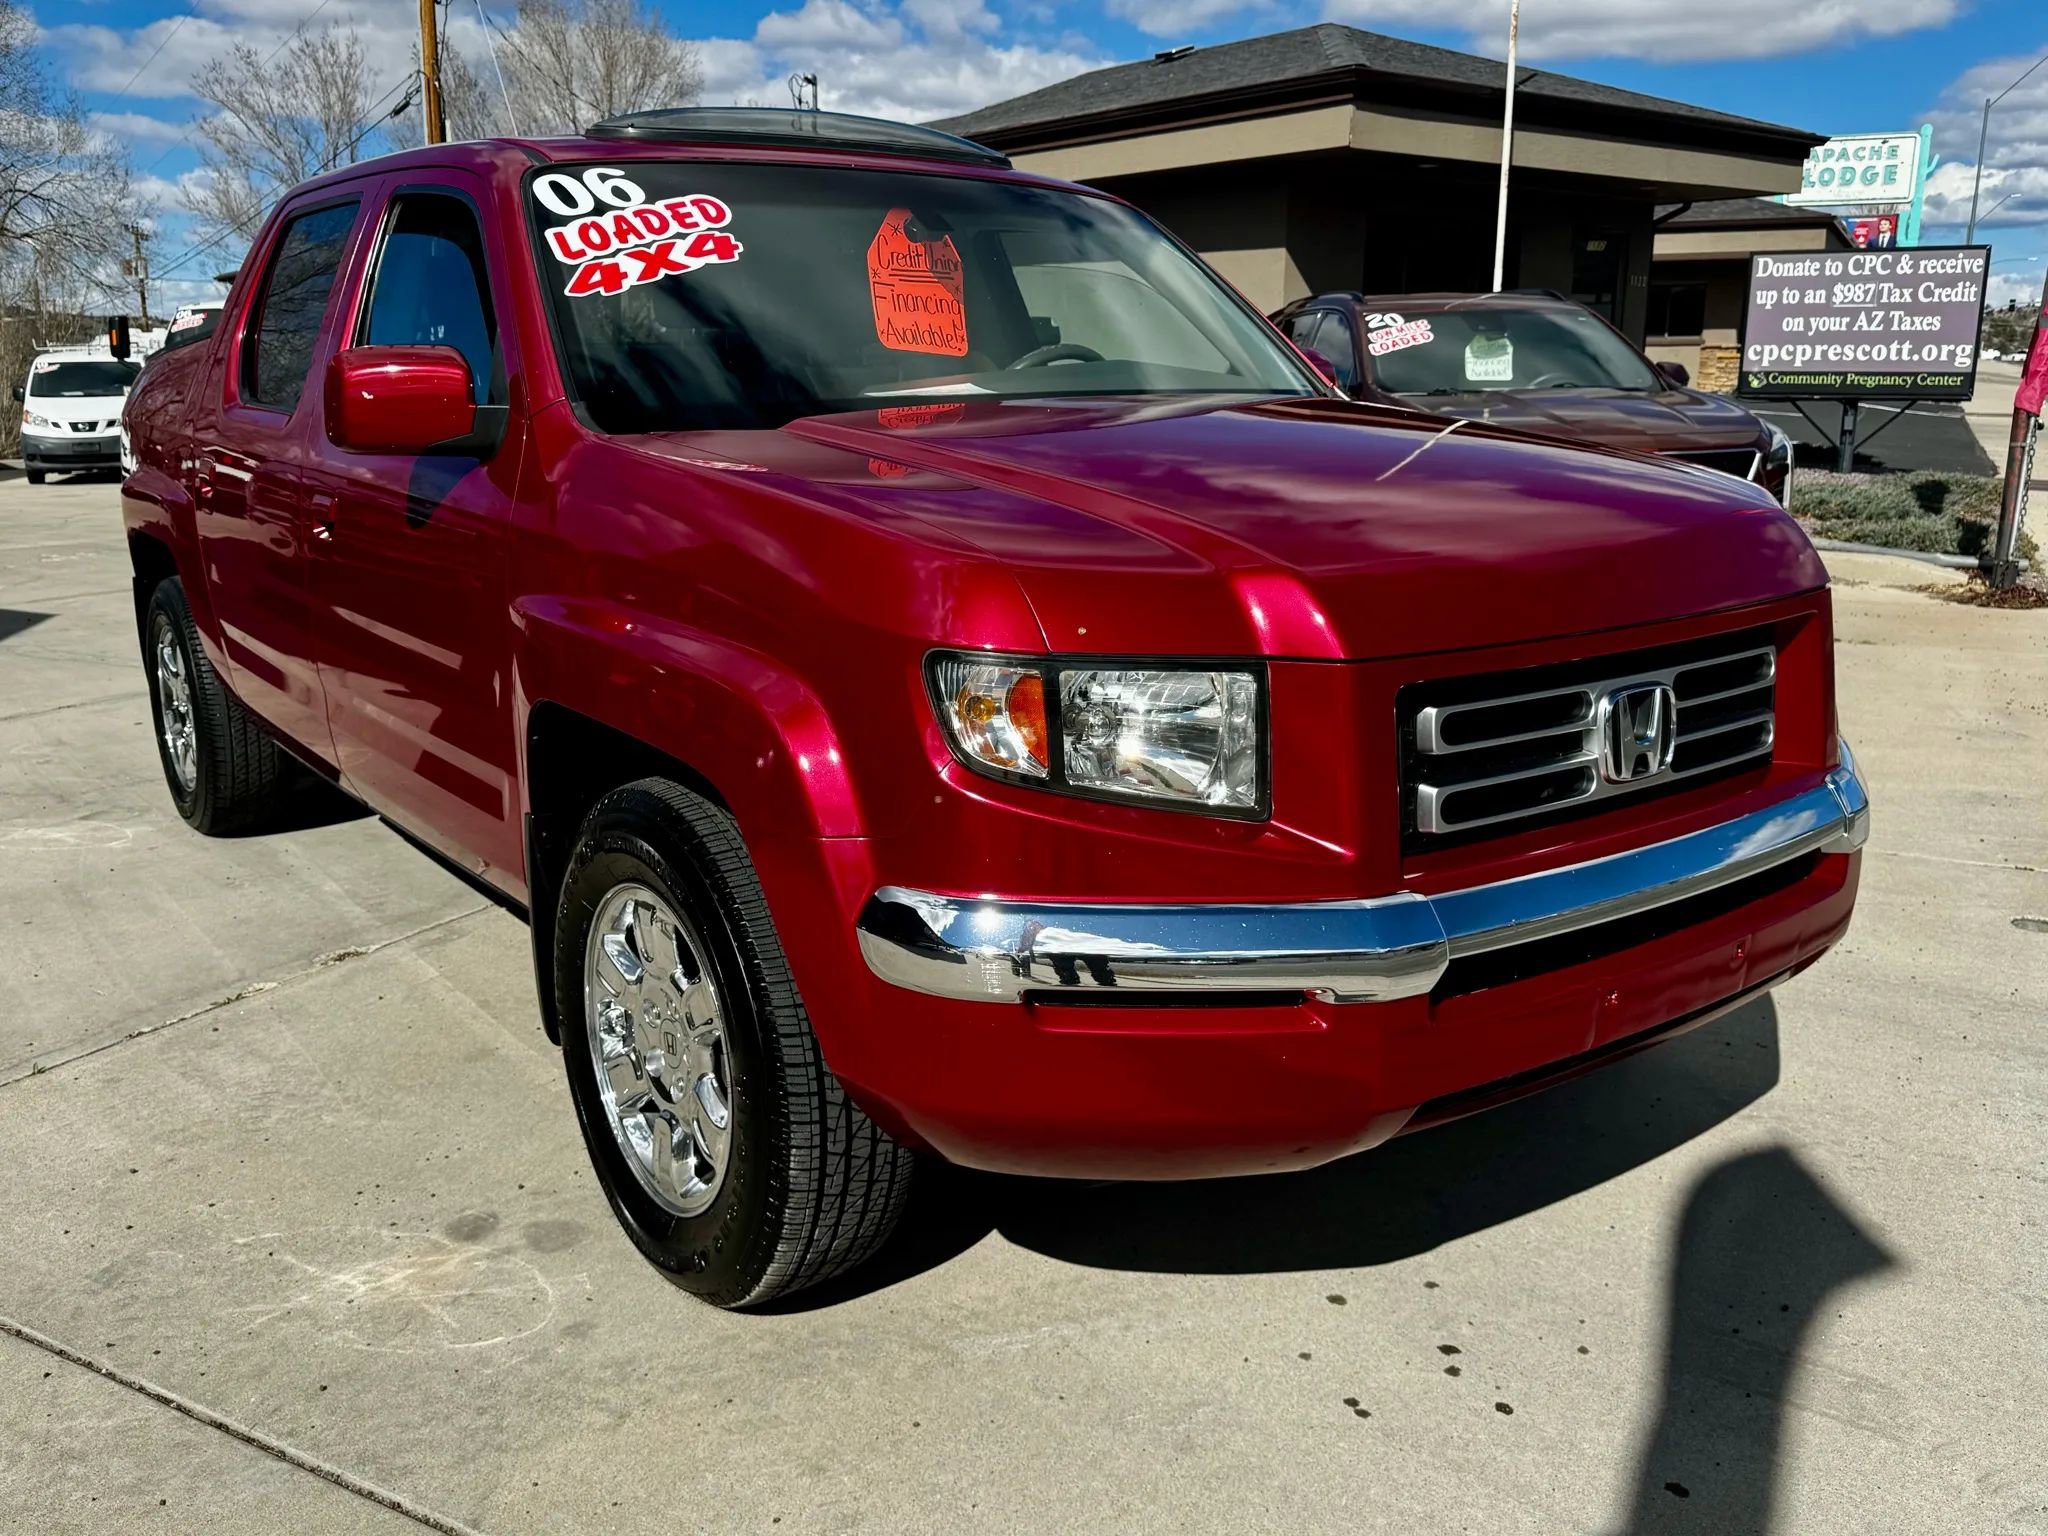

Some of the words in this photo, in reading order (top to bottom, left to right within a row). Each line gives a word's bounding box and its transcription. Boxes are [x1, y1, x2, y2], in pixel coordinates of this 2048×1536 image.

[1806, 145, 1899, 163] APACHE
[1803, 164, 1898, 188] LODGE
[533, 167, 645, 216] 06
[551, 196, 727, 261] LOADED
[567, 233, 740, 294] 4X4
[1756, 257, 1820, 278] Donate
[1825, 261, 1843, 276] to
[1848, 254, 1892, 275] CPC
[1896, 254, 1914, 275] &
[1918, 253, 1984, 275] receive
[873, 282, 964, 331] Financing
[1756, 289, 1777, 309] up
[1782, 287, 1800, 305] to
[1804, 289, 1826, 304] an
[1832, 281, 1876, 306] $987
[1878, 283, 1912, 303] Tax
[1918, 281, 1978, 303] Credit
[1365, 313, 1405, 328] 20
[1370, 329, 1393, 342] LOW
[1396, 320, 1429, 335] MILES
[1782, 316, 1804, 332] on
[1808, 315, 1850, 336] your
[1852, 311, 1886, 331] AZ
[1889, 311, 1941, 331] Taxes
[886, 317, 963, 352] Available!
[1371, 332, 1431, 354] LOADED
[1748, 340, 1973, 368] cpcprescott.org
[1768, 372, 1843, 388] Community
[1846, 373, 1912, 388] Pregnancy
[1916, 373, 1963, 386] Center
